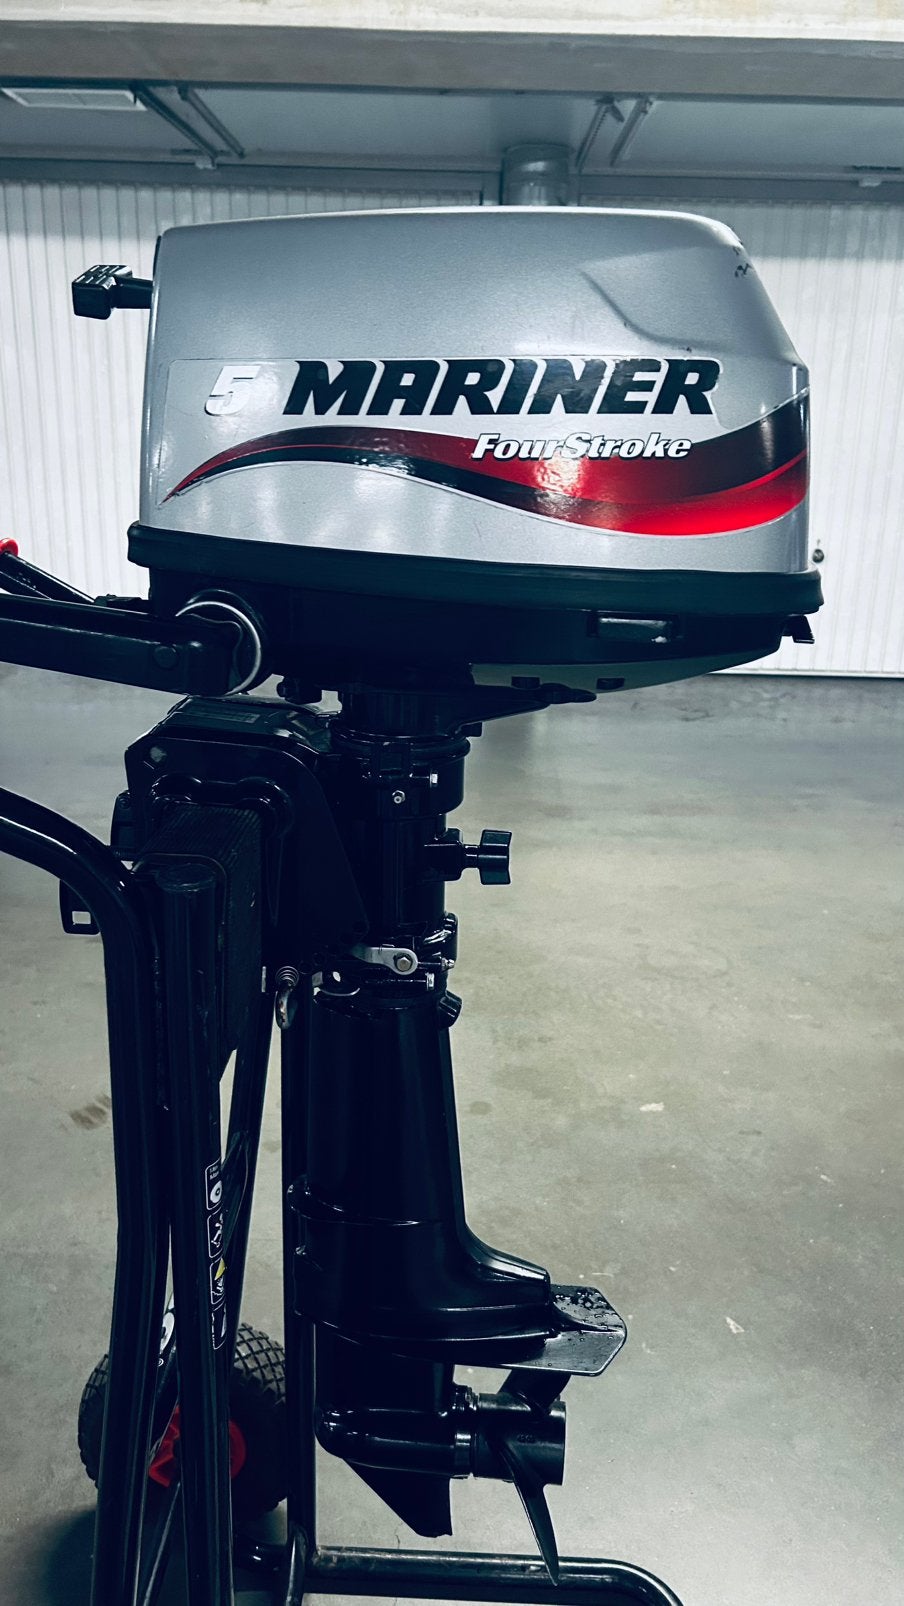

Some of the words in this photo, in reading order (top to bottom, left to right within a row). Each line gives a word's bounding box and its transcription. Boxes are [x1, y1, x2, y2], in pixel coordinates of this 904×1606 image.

[204, 365, 261, 416] 5
[282, 359, 719, 415] MARINER
[471, 432, 692, 460] FourStroke
